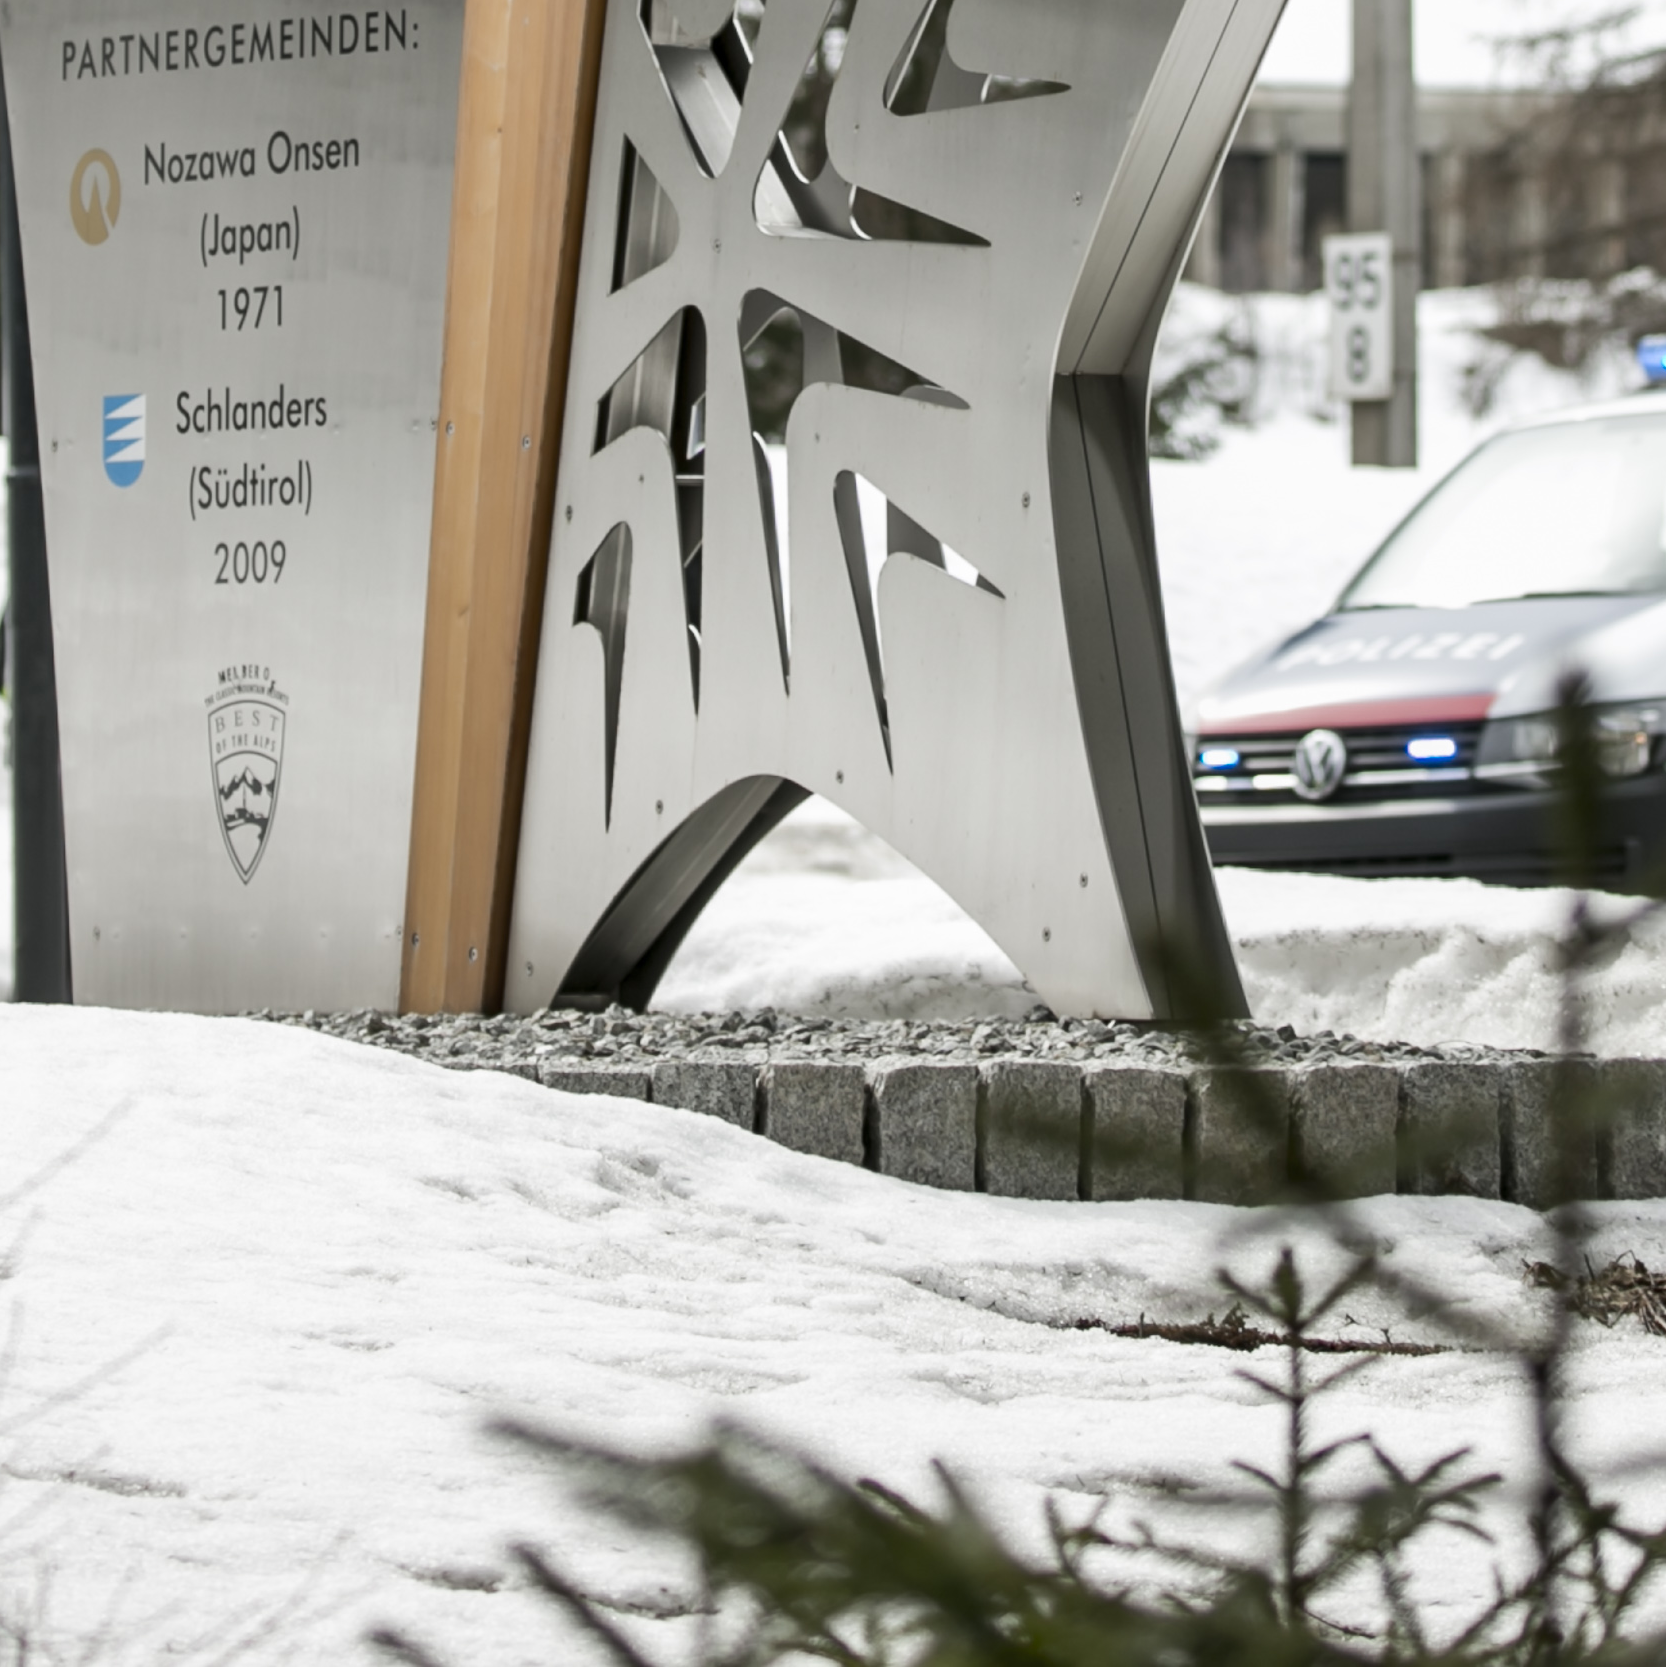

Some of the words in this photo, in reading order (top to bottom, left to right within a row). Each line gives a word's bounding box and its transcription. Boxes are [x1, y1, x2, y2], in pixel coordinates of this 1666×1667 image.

[62, 8, 420, 81] PARTNERGEMEINDEN:
[144, 142, 256, 185] Nozawa
[266, 130, 360, 175] Onsen
[200, 205, 300, 268] (Japan)
[217, 285, 284, 332] 1971
[1345, 325, 1371, 384] 8
[176, 383, 328, 435] Schlanders
[189, 459, 312, 522] (Südtirol)
[214, 540, 287, 586] 2009
[215, 709, 279, 734] BEST
